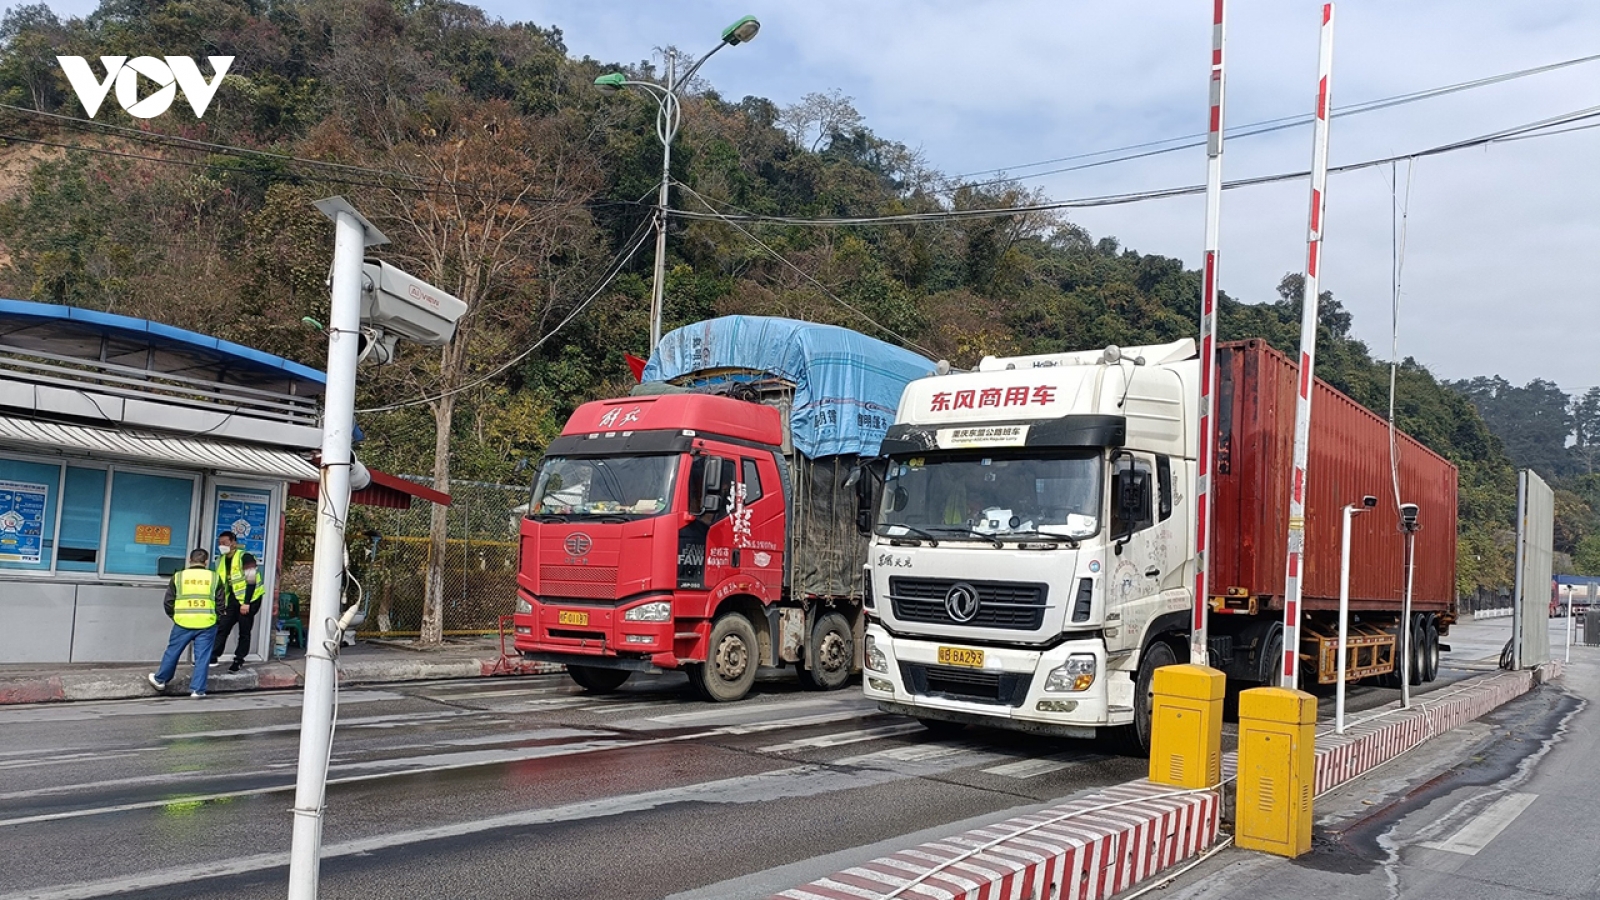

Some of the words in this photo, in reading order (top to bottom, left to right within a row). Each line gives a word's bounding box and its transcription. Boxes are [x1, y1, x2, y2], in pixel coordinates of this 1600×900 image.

[930, 385, 1057, 412] 东风商用车
[677, 554, 705, 566] FAW
[187, 599, 206, 608] 153
